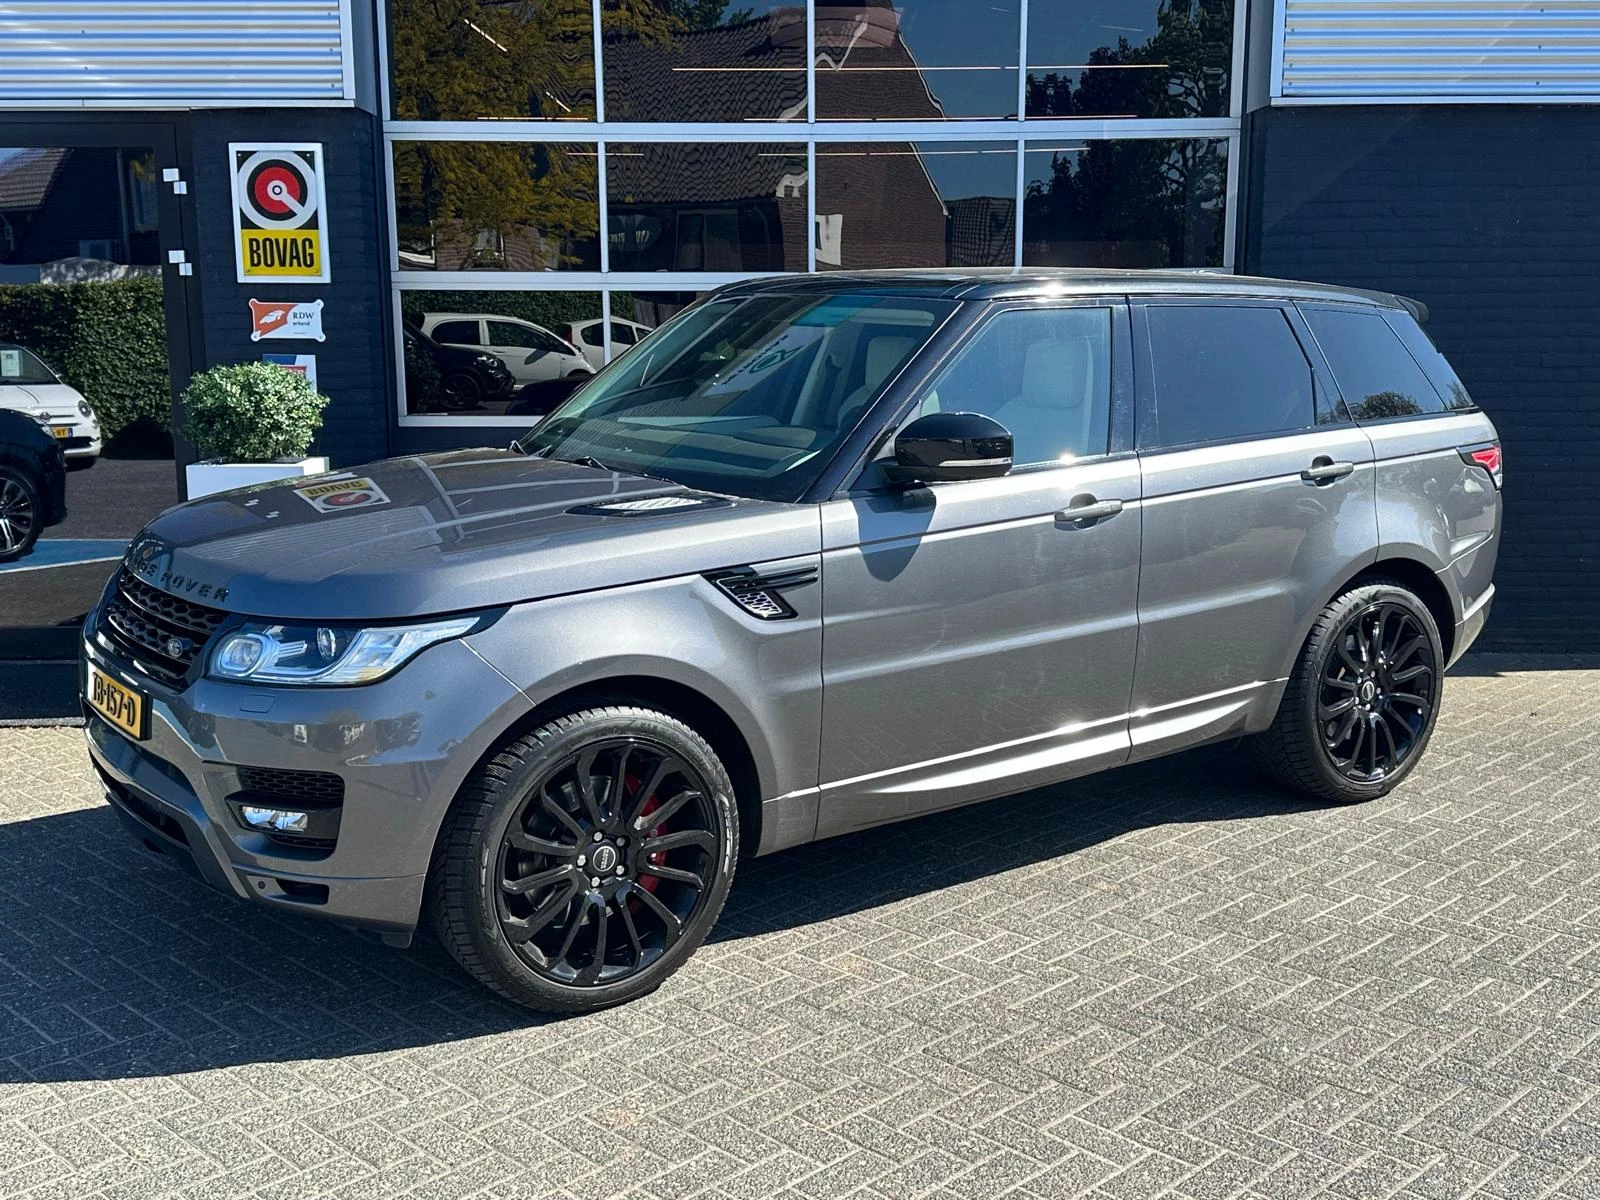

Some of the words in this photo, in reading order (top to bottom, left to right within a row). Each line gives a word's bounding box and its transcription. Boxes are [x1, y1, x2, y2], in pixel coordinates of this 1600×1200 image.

[248, 237, 314, 268] BOVAG
[292, 311, 314, 319] RDW
[160, 570, 229, 603] ROVER
[92, 671, 136, 728] TB-157-D
